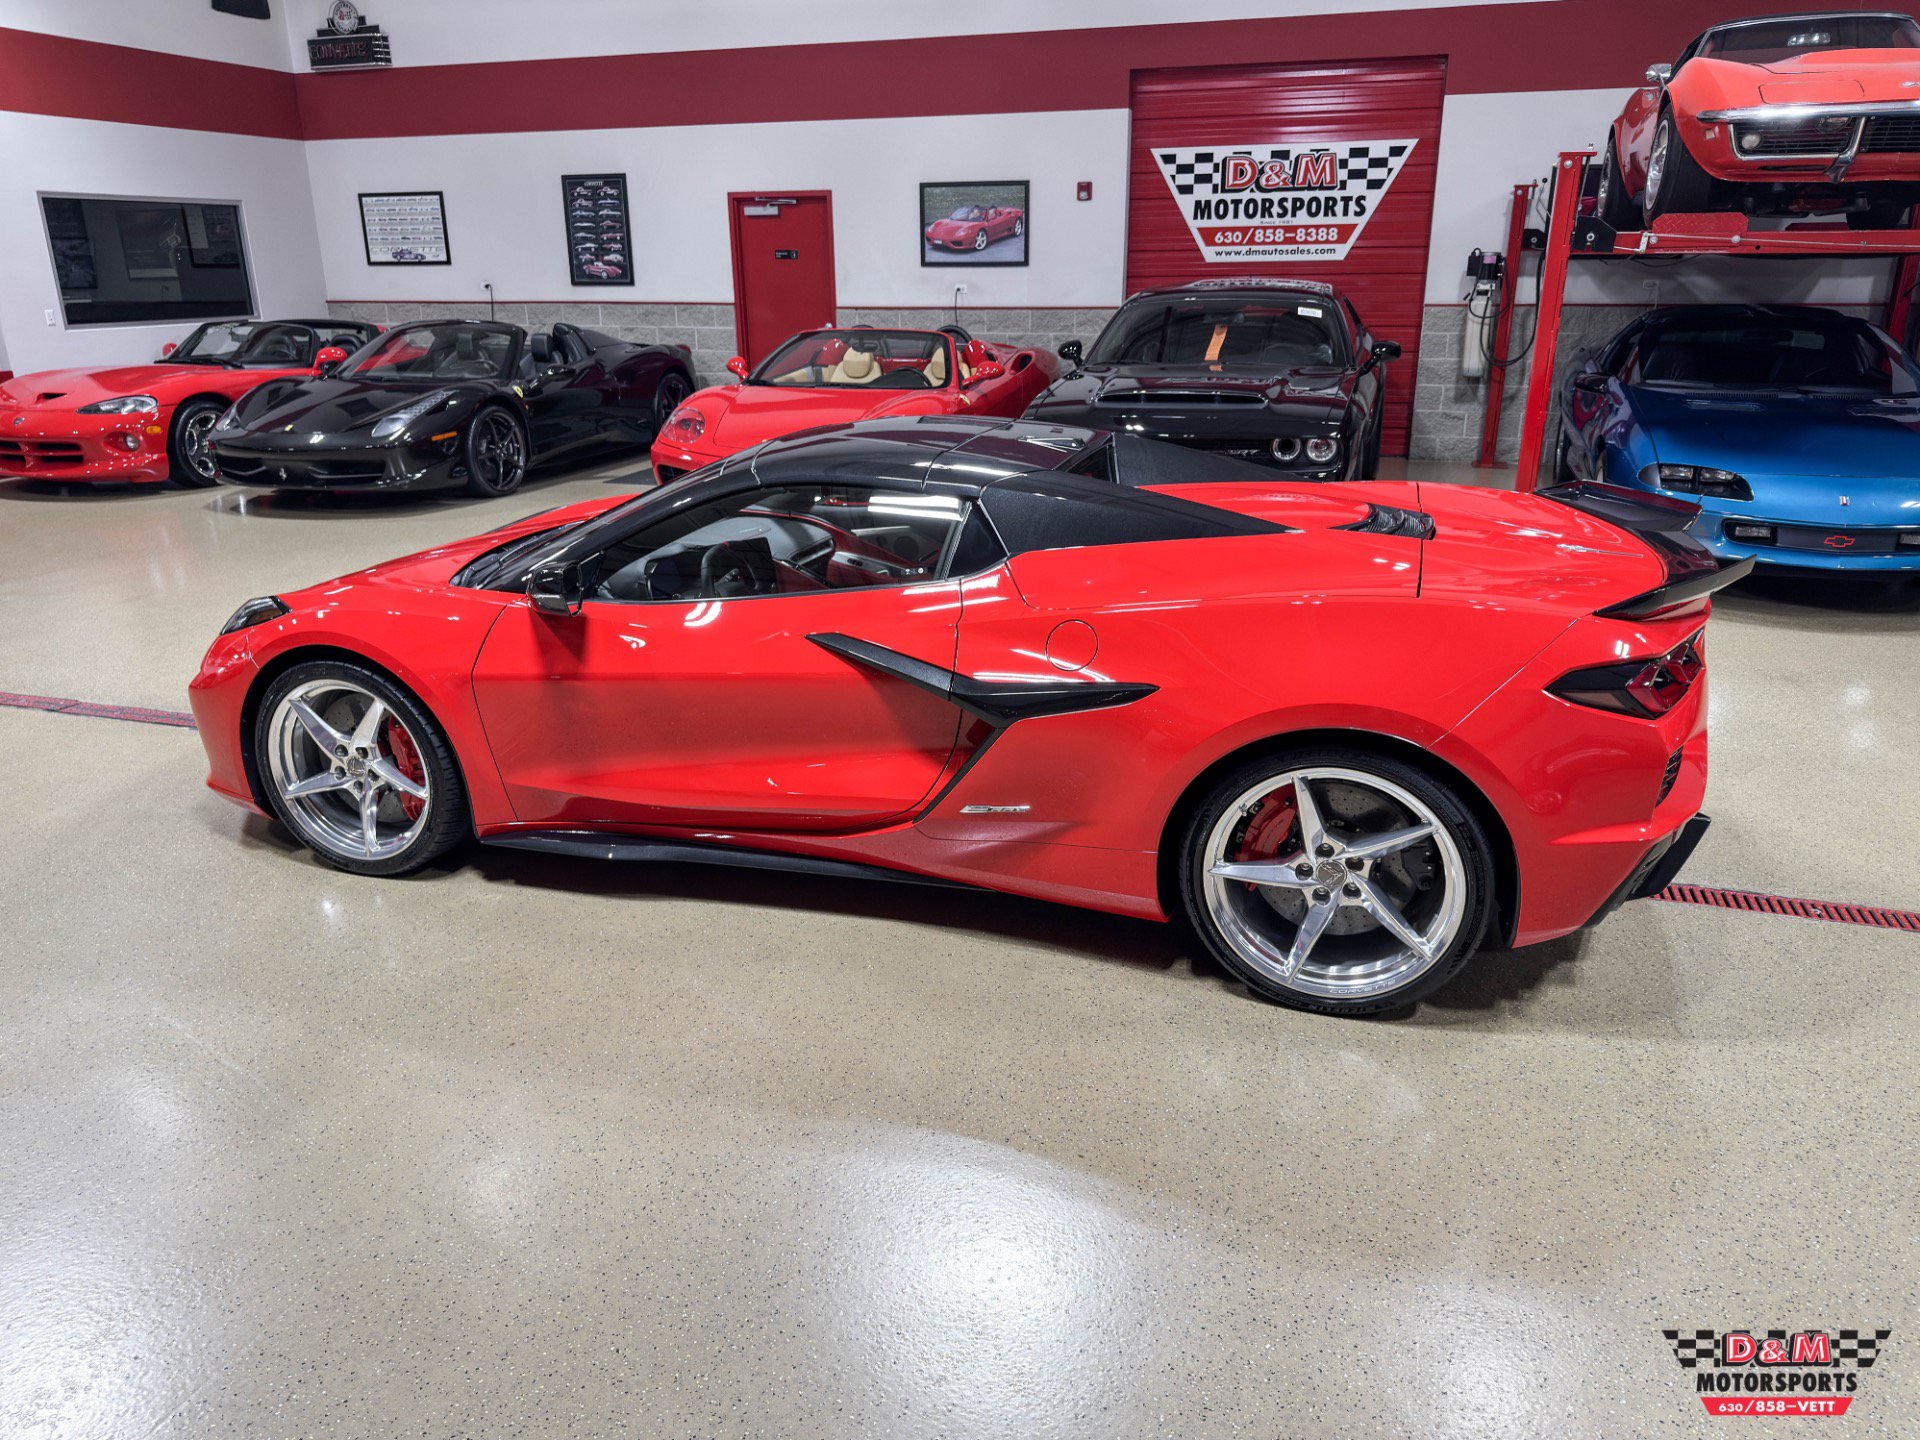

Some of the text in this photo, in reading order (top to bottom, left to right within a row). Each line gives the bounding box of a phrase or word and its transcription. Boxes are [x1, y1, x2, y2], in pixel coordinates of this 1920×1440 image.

[1221, 152, 1339, 193] D&M
[1193, 195, 1367, 220] MOTORSPORTS
[1215, 246, 1336, 257] www.dmautosales.com
